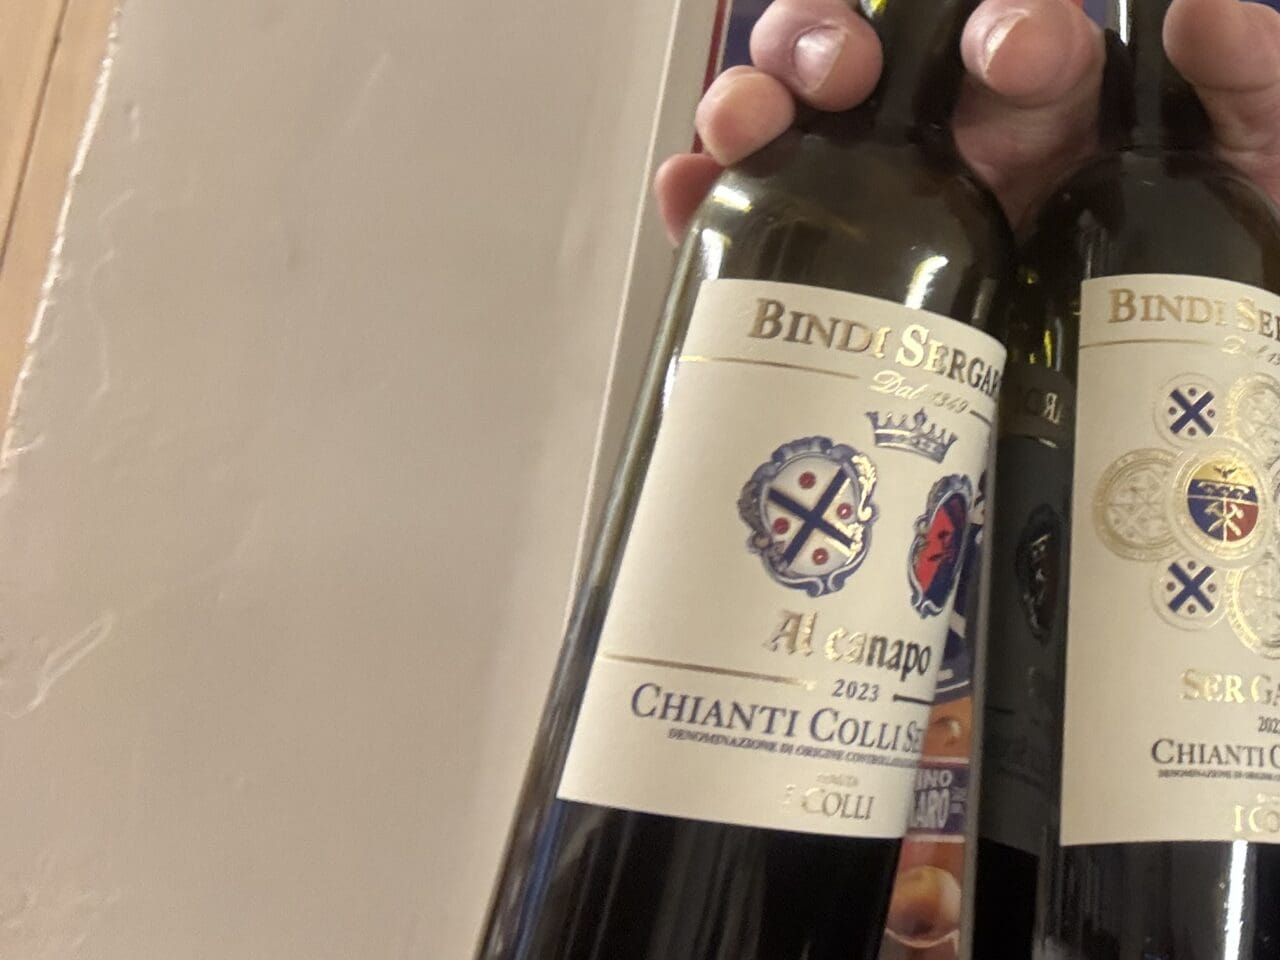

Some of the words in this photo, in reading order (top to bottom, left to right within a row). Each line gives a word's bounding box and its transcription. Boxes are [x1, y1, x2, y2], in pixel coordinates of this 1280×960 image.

[1108, 288, 1227, 327] BINDI
[748, 297, 892, 359] BINDI
[824, 626, 931, 682] canapo
[831, 678, 880, 704] 2023
[1179, 668, 1246, 704] SER
[630, 681, 801, 738] CHIANTI
[809, 706, 902, 753] COLLI
[1151, 738, 1264, 768] CHIANTI
